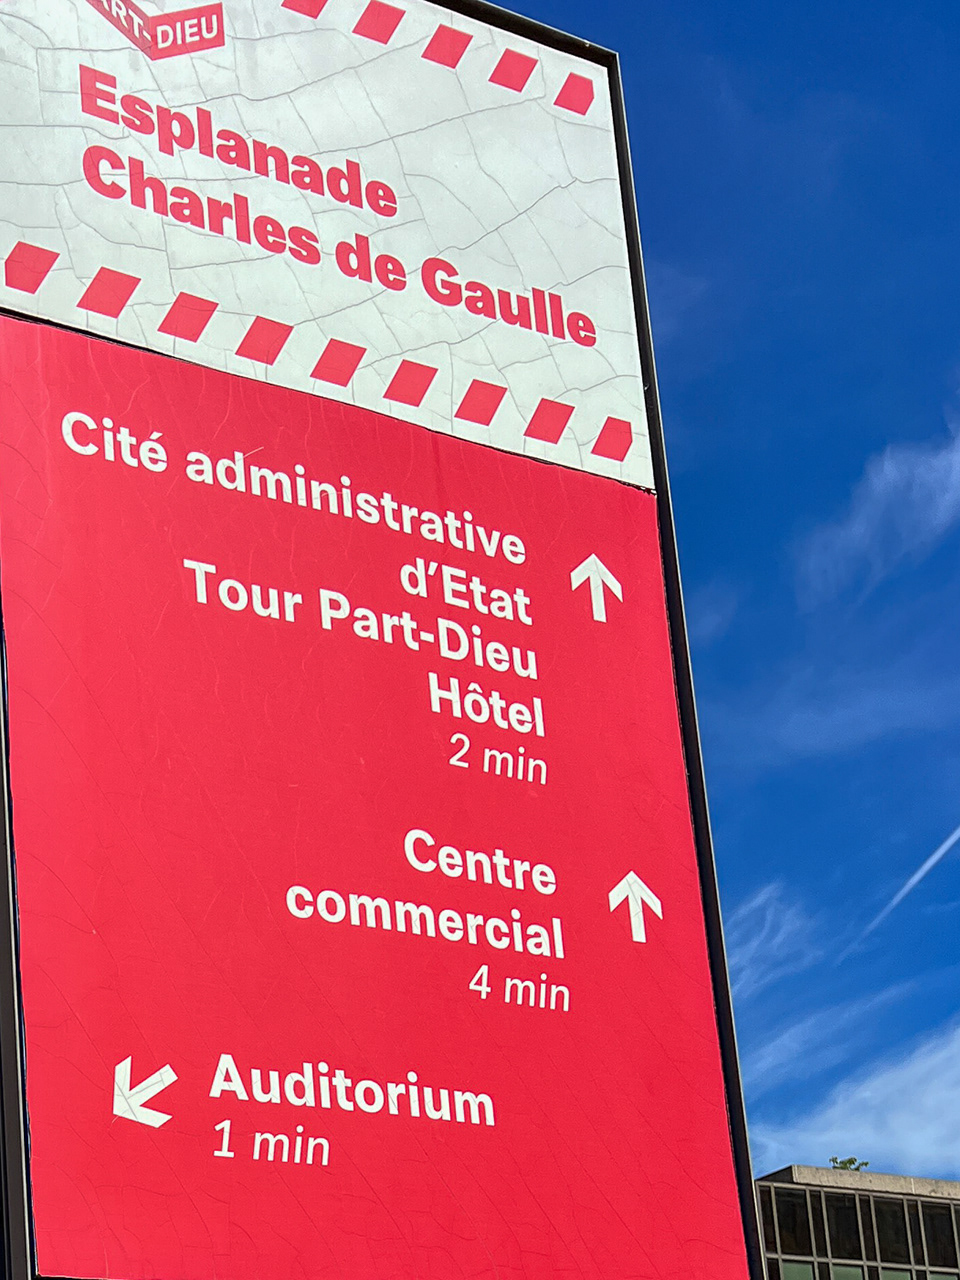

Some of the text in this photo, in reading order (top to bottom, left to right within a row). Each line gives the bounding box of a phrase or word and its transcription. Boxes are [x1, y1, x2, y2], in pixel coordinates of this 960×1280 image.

[79, 64, 397, 218] Esplanade
[82, 144, 597, 347] Charles de Gaulle
[60, 412, 526, 565] Cité administrative
[183, 559, 539, 681] Tour Part-Dieu
[400, 558, 533, 626] d'Etat
[429, 673, 546, 737] Hôtel
[449, 734, 548, 786] 2 min
[404, 828, 557, 895] Centre
[286, 885, 565, 959] commercial
[469, 965, 571, 1012] 4 min
[209, 1052, 496, 1127] Auditorium
[213, 1120, 330, 1166] 1 min
